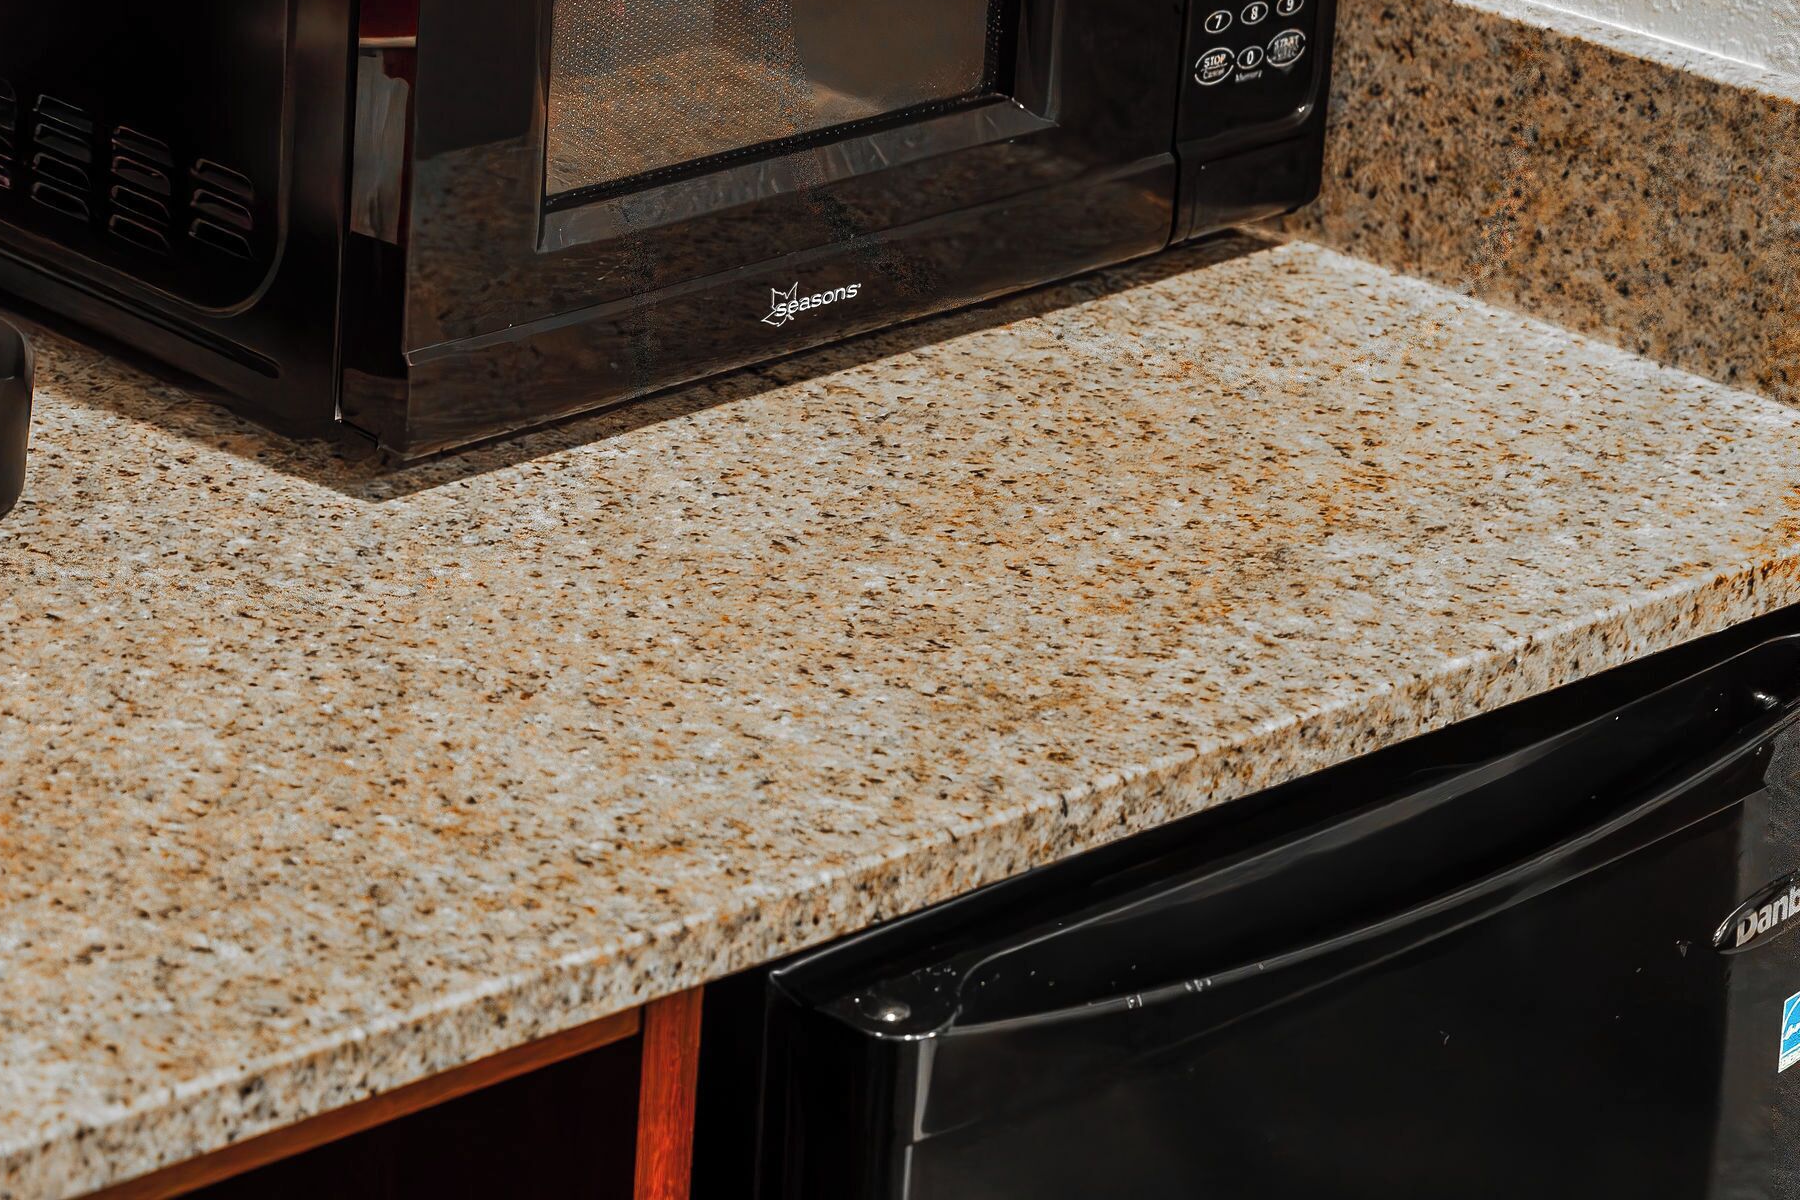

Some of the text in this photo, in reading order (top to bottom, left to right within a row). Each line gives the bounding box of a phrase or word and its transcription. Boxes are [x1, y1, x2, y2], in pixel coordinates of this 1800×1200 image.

[1215, 14, 1222, 29] 7
[1251, 6, 1259, 20] 8
[1246, 50, 1254, 65] 0
[774, 284, 859, 318] seasons
